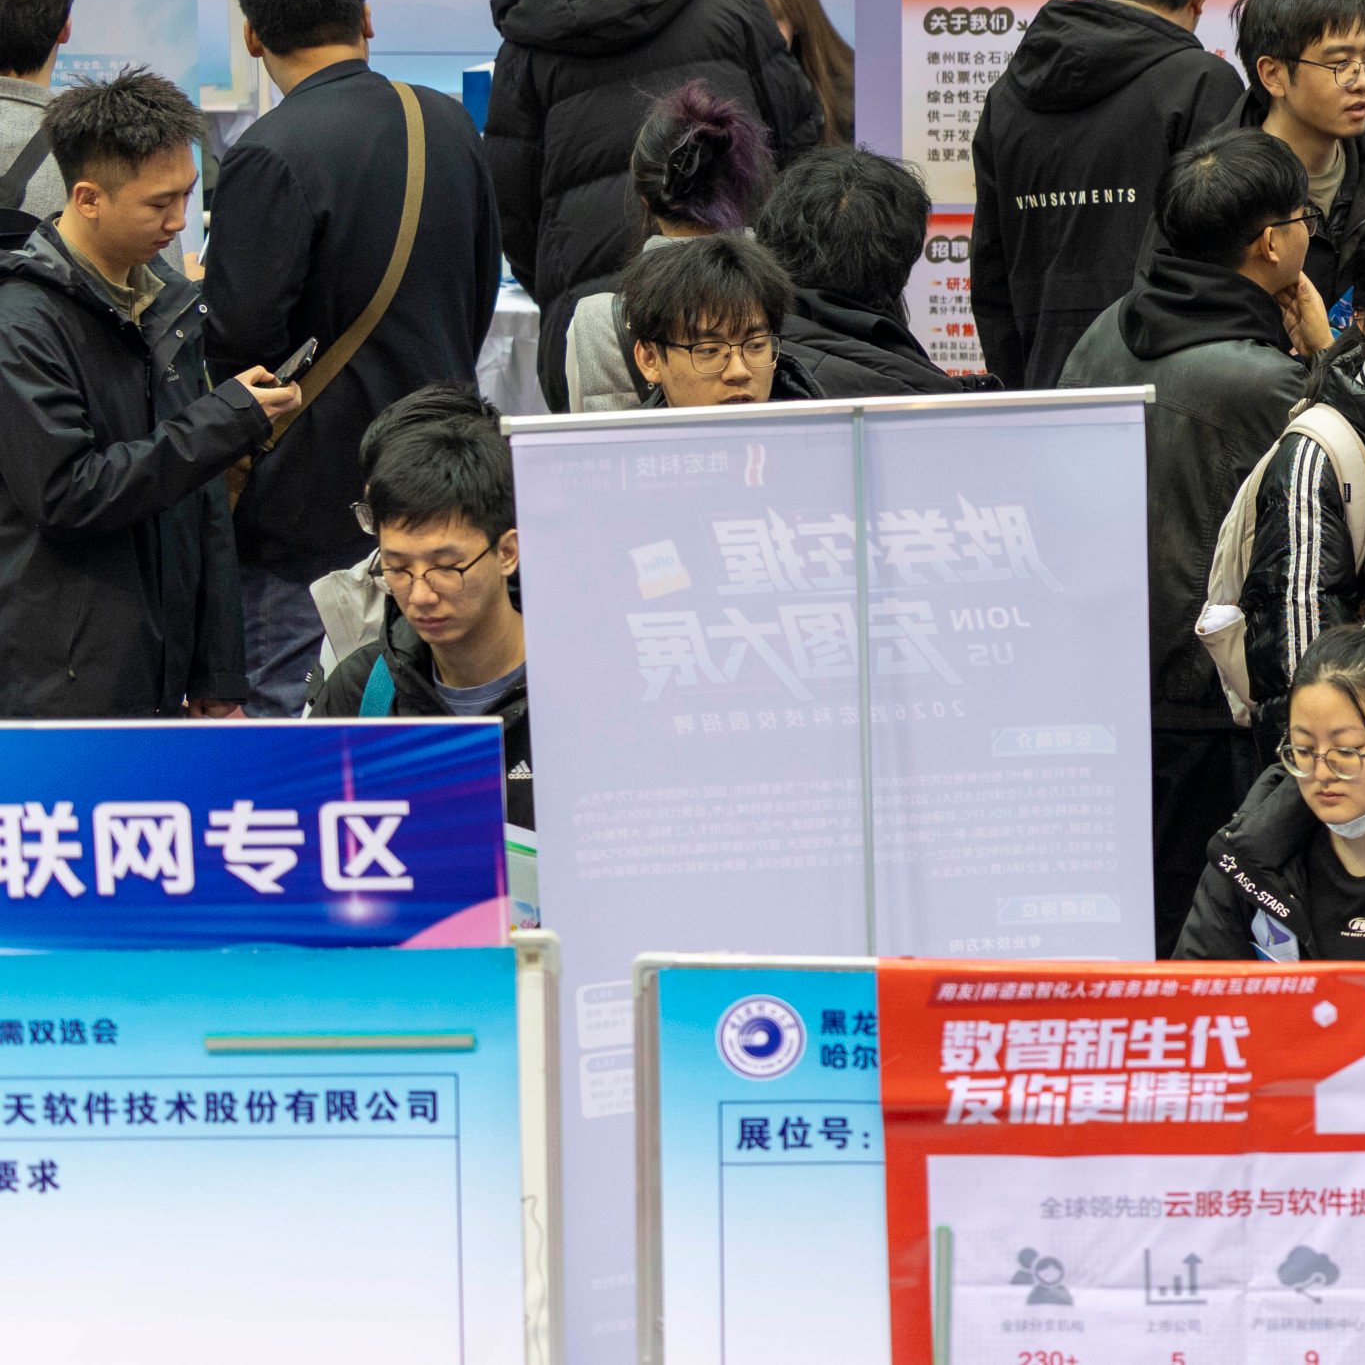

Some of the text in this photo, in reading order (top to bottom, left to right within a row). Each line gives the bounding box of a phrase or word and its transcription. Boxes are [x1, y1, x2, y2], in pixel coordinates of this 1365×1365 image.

[929, 12, 1009, 32] 关于我们
[926, 149, 972, 163] 造更高
[1234, 871, 1291, 919] ASC-STARS
[940, 1015, 1252, 1074] 数智新生代
[3, 1089, 440, 1126] 天软件技术股份有限公司
[943, 1071, 1252, 1126] 友你更精彩
